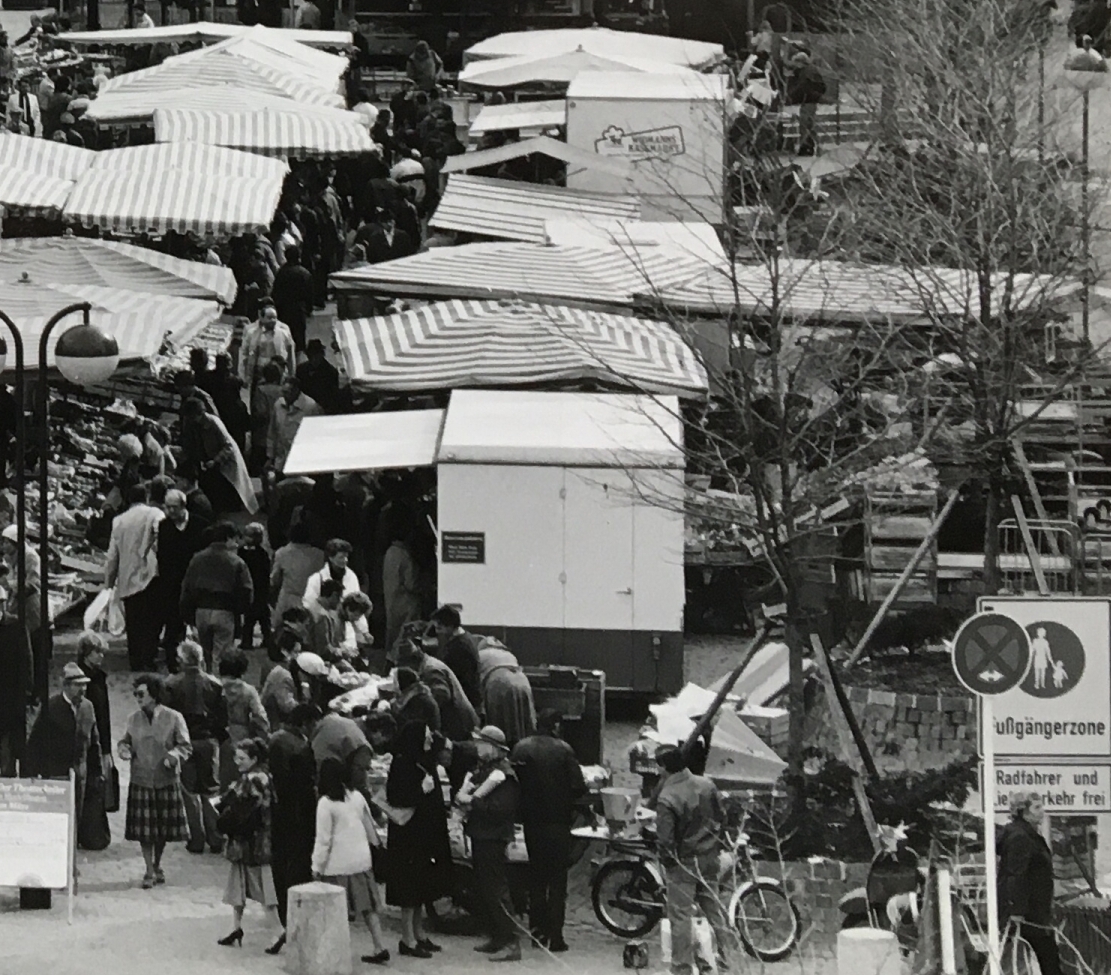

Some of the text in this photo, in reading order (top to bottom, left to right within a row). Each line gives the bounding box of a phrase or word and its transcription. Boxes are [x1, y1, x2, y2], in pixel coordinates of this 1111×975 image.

[993, 716, 1106, 741] ußgängerzone
[995, 769, 1099, 786] Radfahrer und
[994, 791, 1106, 807] ierkehr frei
